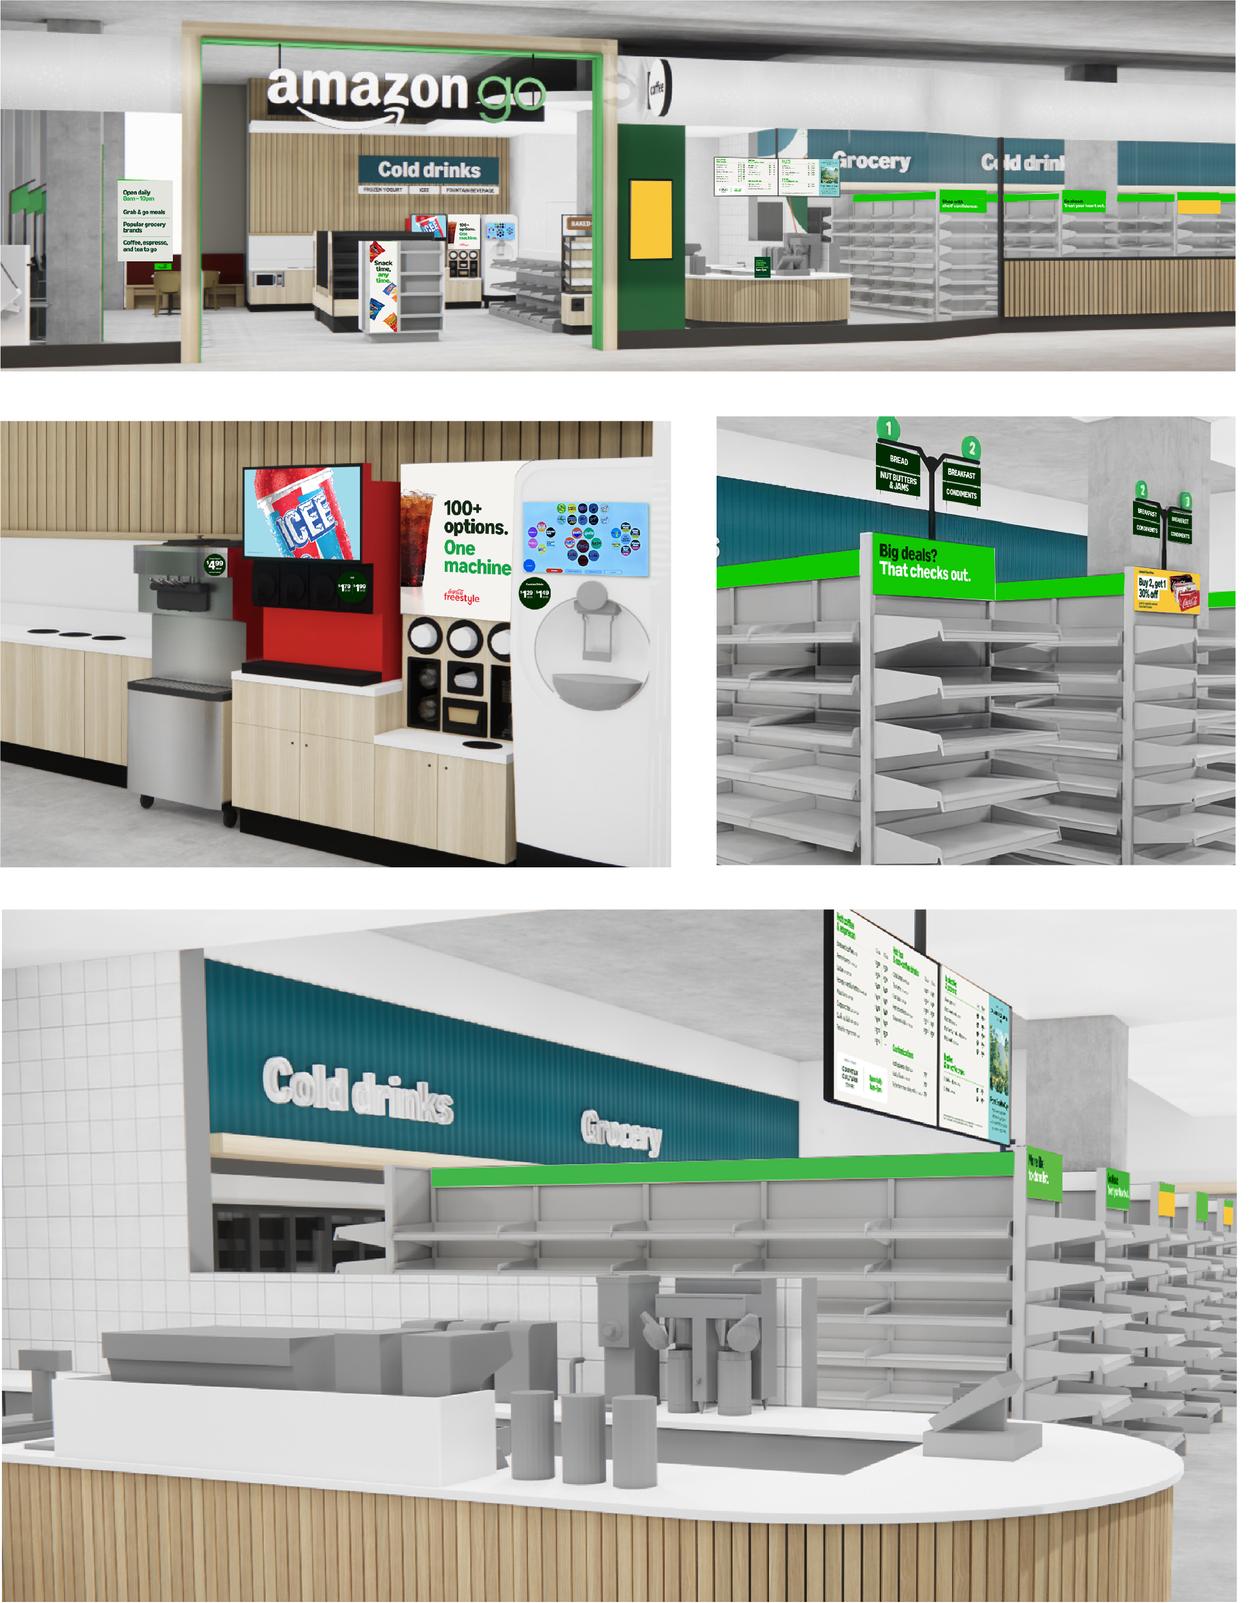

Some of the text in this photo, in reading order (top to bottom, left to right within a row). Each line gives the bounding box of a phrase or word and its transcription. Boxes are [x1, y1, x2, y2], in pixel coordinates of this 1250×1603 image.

[267, 67, 547, 123] amazon go
[378, 161, 481, 178] Cold drinks
[833, 150, 912, 174] Grocery
[885, 420, 892, 436] 1
[969, 441, 976, 456] 2
[889, 454, 909, 466] BREAD
[879, 470, 918, 486] NUT BUTTERS
[947, 467, 976, 480] BREAKFAST
[893, 483, 910, 492] JAMS
[946, 488, 978, 500] CONDIMENTS
[1139, 484, 1146, 496] 2
[443, 500, 483, 516] 100+
[276, 494, 338, 551] ICEE
[443, 518, 509, 537] options.
[443, 539, 476, 556] One
[879, 543, 938, 563] Big deals?
[879, 560, 972, 583] That checks out.
[1138, 577, 1149, 589] Buy
[1154, 579, 1163, 589] get
[444, 592, 481, 606] freestyle
[1138, 588, 1159, 600] 30% off
[263, 1056, 455, 1125] Cold drinks
[581, 1109, 663, 1158] Grocery
